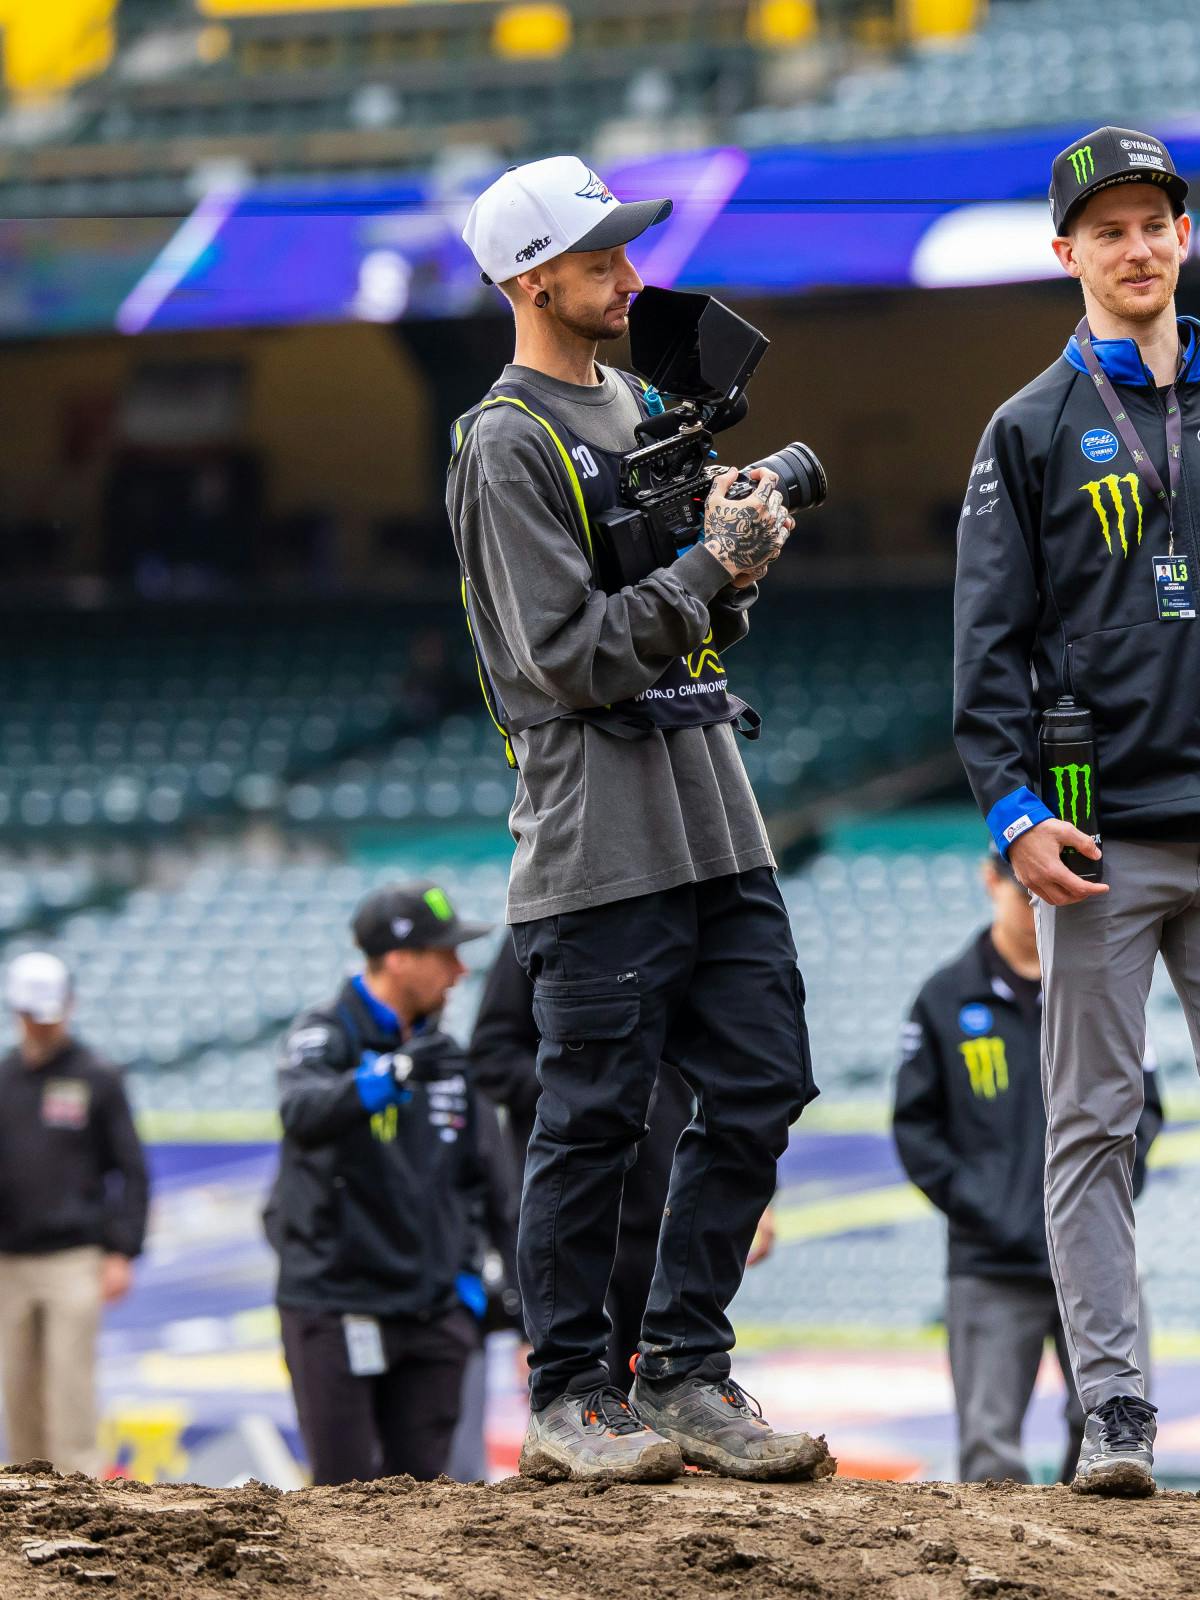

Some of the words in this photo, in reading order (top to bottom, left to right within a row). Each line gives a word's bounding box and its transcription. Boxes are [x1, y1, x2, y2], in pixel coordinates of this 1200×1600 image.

[1131, 140, 1163, 155] YAMAHA
[1172, 564, 1189, 582] L3
[634, 688, 675, 702] WORLD
